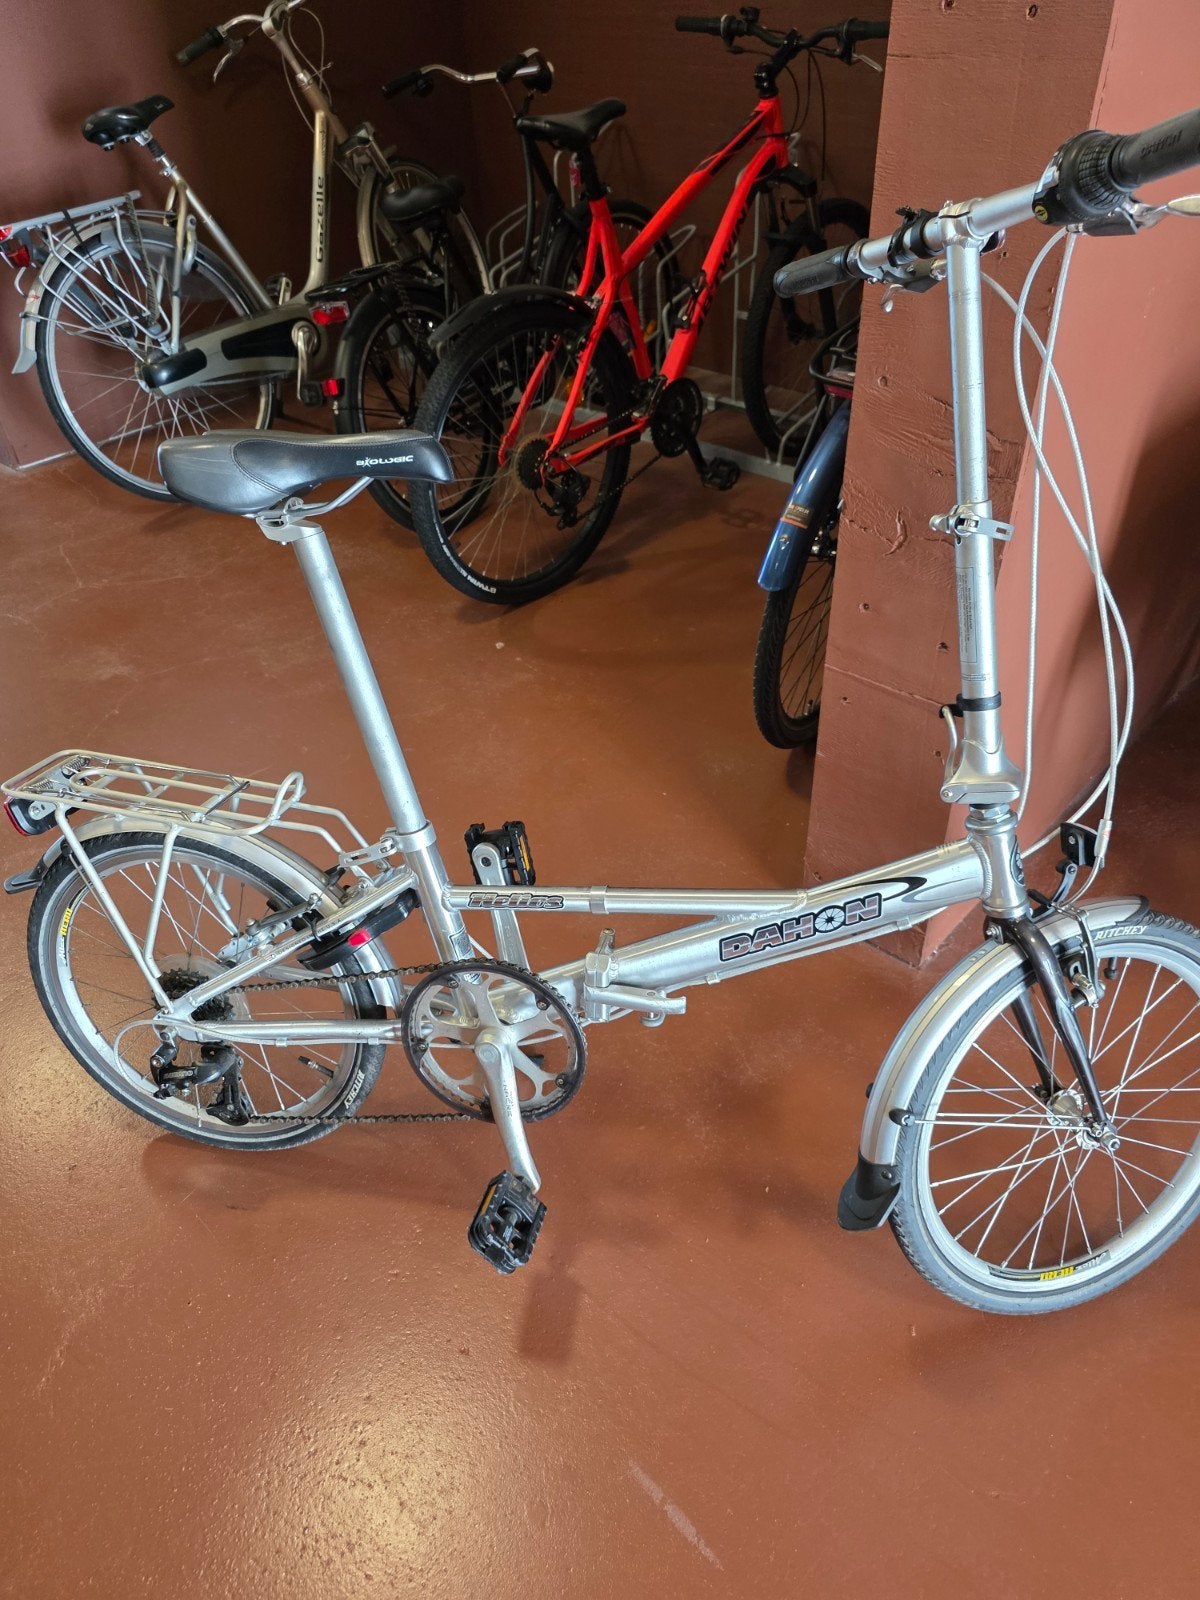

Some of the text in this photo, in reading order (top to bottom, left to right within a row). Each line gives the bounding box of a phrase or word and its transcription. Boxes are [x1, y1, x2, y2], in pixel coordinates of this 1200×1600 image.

[315, 175, 324, 263] Gazelle
[469, 892, 564, 909] Helios
[720, 893, 882, 961] DAHON
[1093, 925, 1147, 941] RITCHEY
[344, 1069, 365, 1109] RITCHEY
